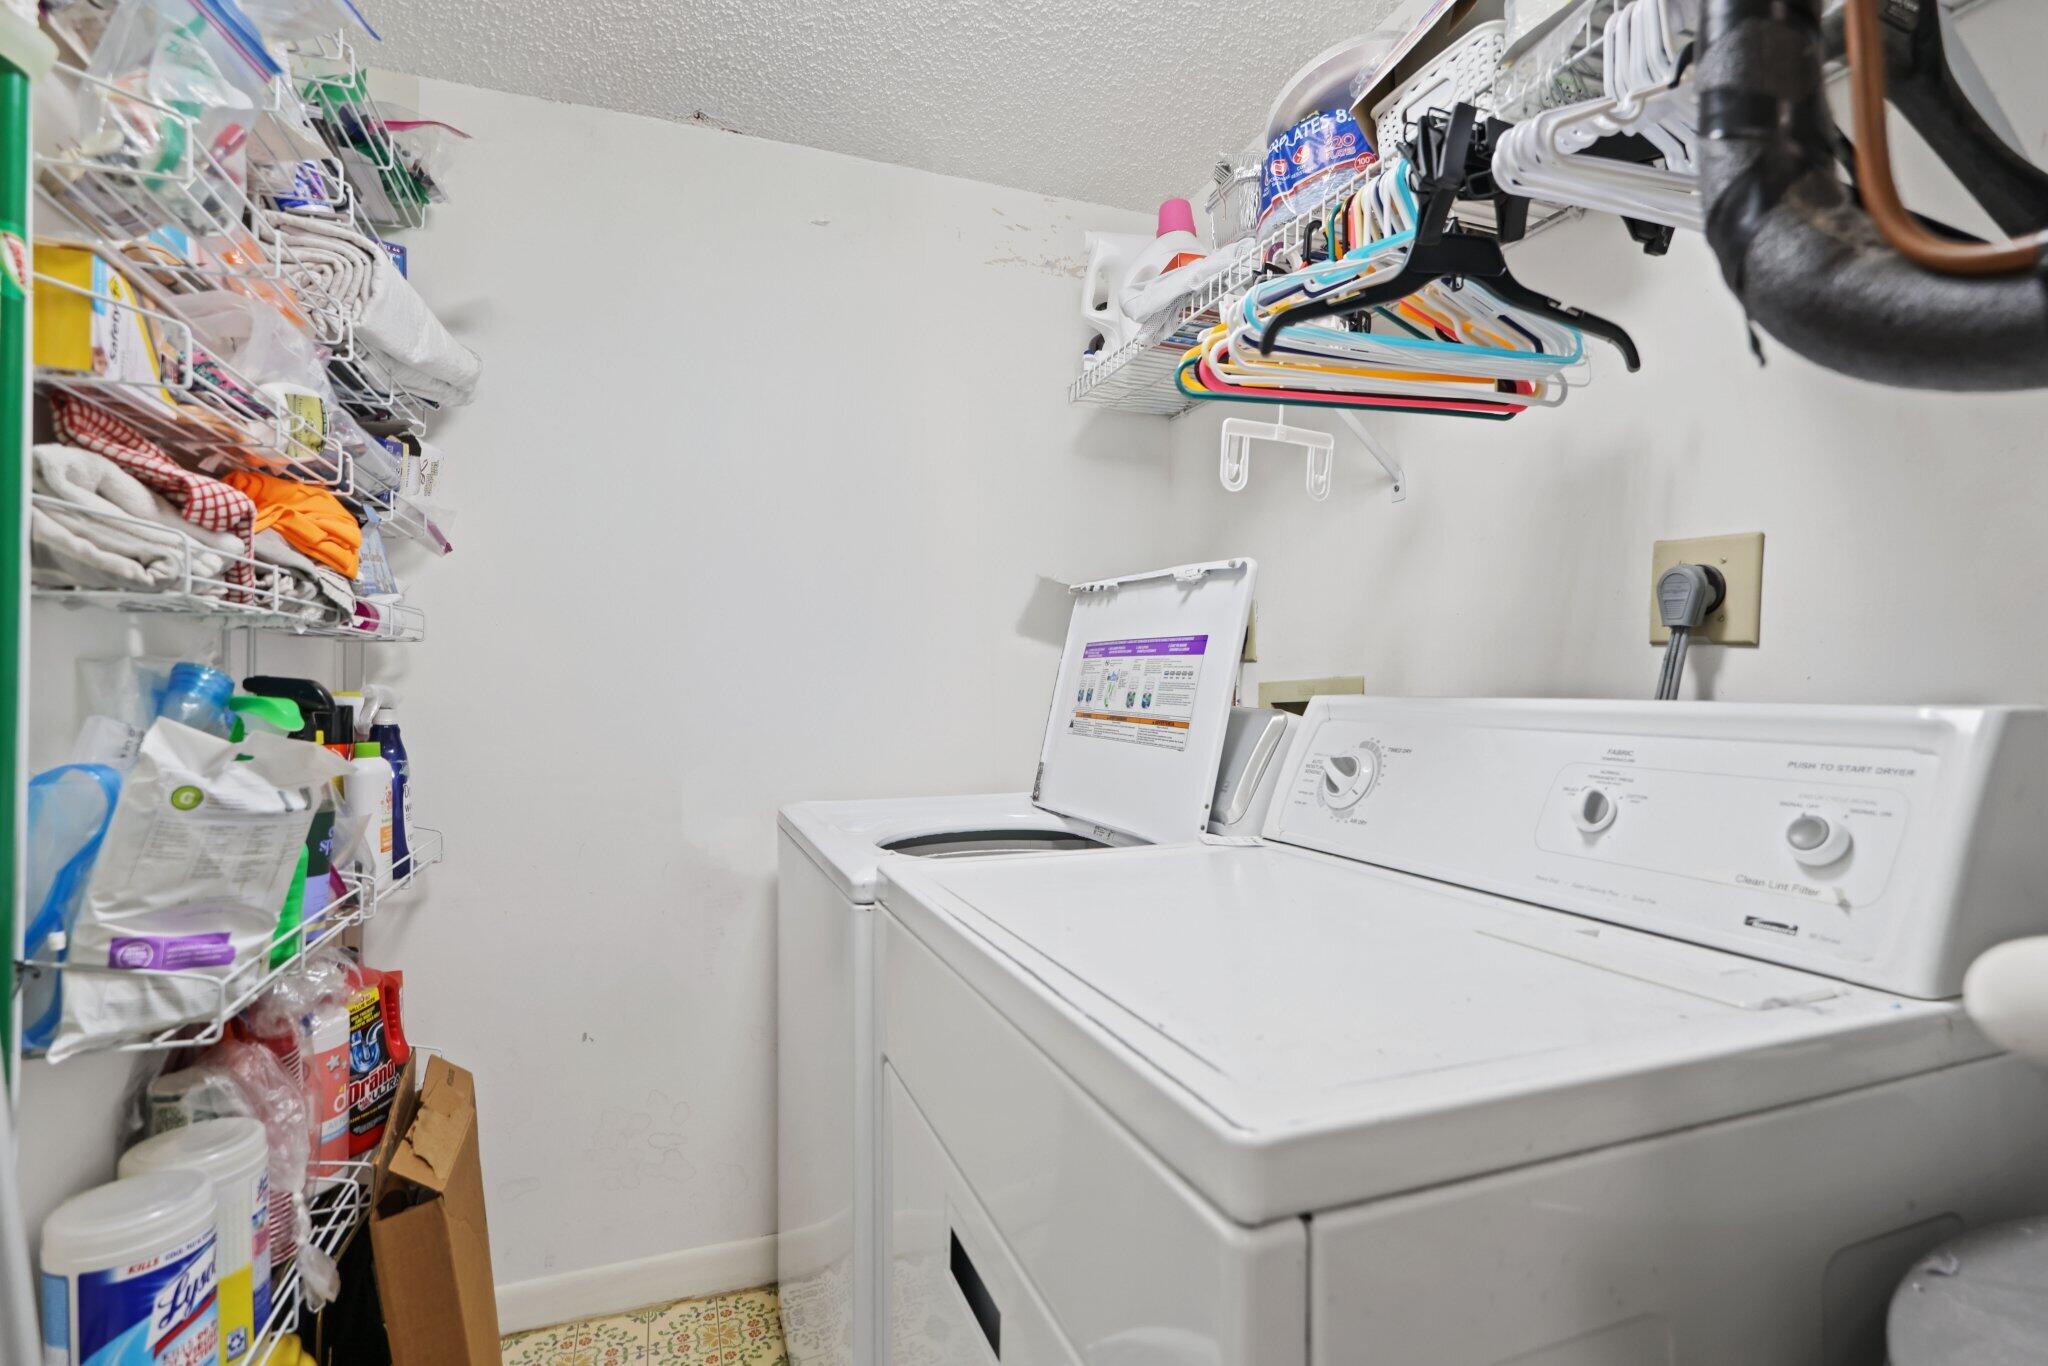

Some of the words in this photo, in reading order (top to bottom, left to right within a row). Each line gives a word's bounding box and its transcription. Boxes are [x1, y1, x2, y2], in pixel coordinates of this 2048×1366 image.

[1787, 761, 1817, 770] PUSH
[1820, 763, 1834, 771] TO
[1836, 765, 1873, 774] START
[1875, 767, 1916, 776] DRYER
[1735, 873, 1766, 887] Clean
[1768, 880, 1789, 892] Lint
[1791, 883, 1820, 897] Filter
[128, 1257, 160, 1275] KILLS
